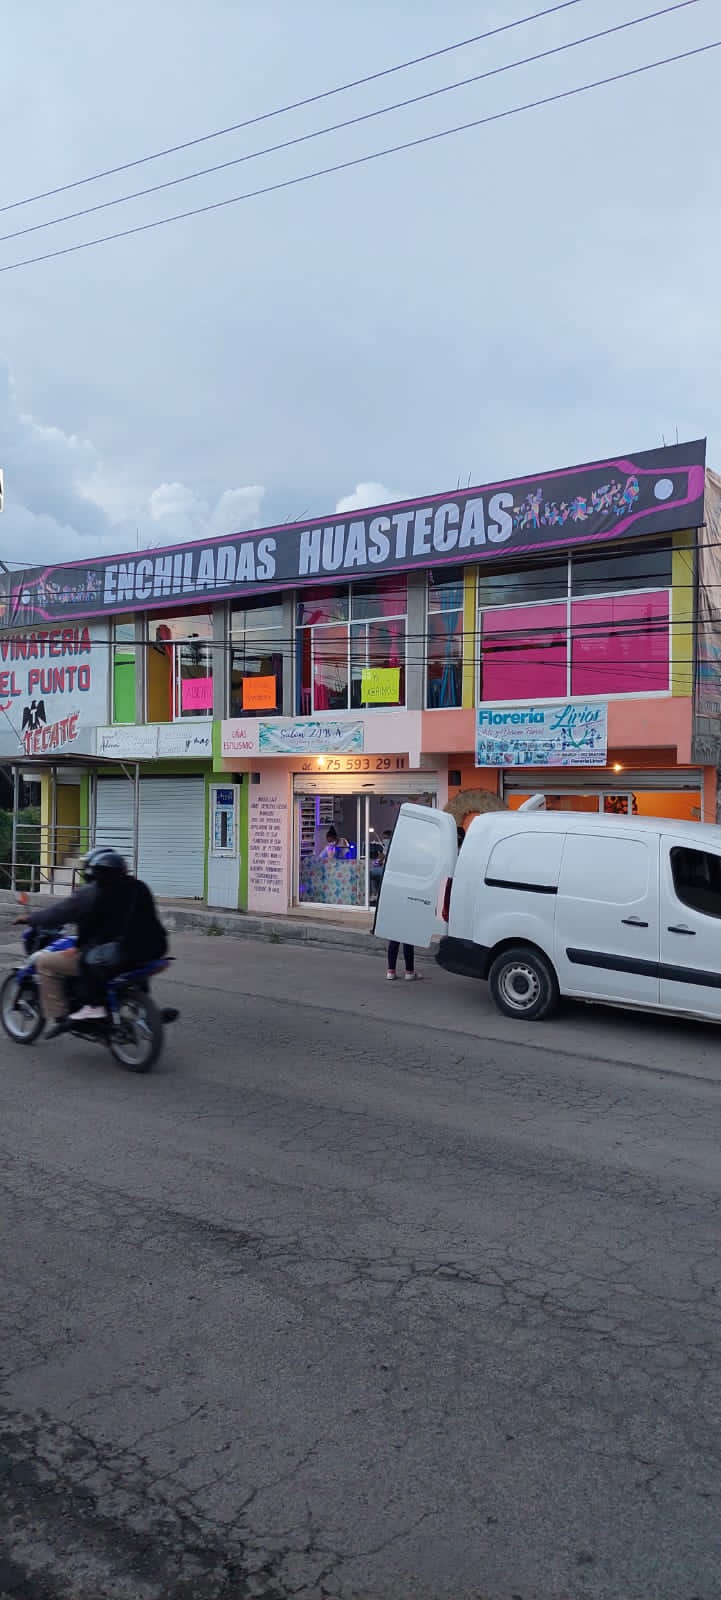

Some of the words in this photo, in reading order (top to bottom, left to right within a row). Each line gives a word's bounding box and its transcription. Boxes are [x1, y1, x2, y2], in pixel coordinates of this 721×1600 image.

[103, 537, 277, 604] ENCHILADAS
[299, 492, 514, 575] HUASTECAS
[1, 626, 92, 661] VINATERIA
[28, 664, 91, 696] PUNTO
[478, 707, 545, 725] Florería
[22, 713, 80, 754] TECATE
[346, 759, 370, 770] 593
[376, 758, 391, 770] 29
[396, 757, 405, 769] 11
